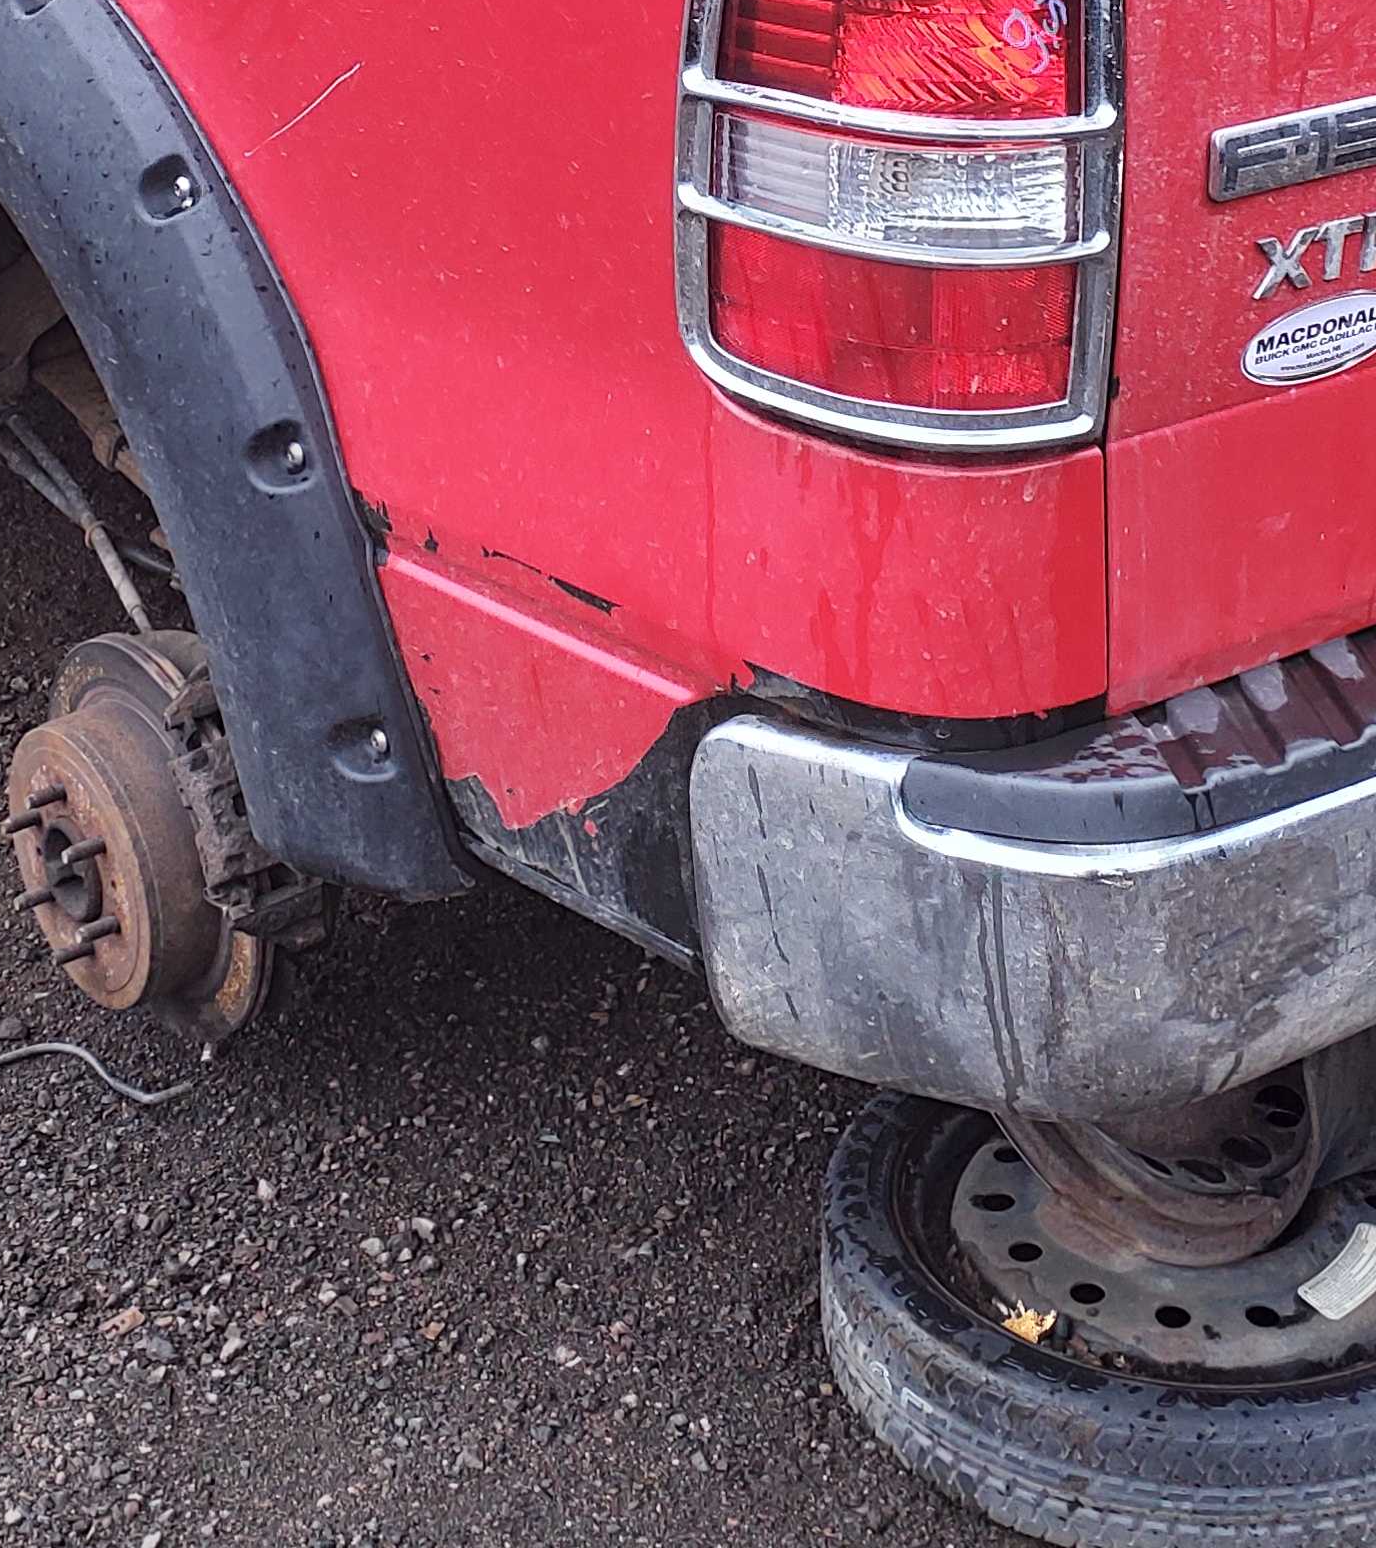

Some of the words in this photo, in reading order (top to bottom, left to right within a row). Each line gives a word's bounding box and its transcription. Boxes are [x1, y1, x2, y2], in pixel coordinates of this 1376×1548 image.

[1255, 348, 1290, 365] BUICK
[1292, 340, 1318, 354] GMC
[1319, 324, 1373, 346] CADILLAC
